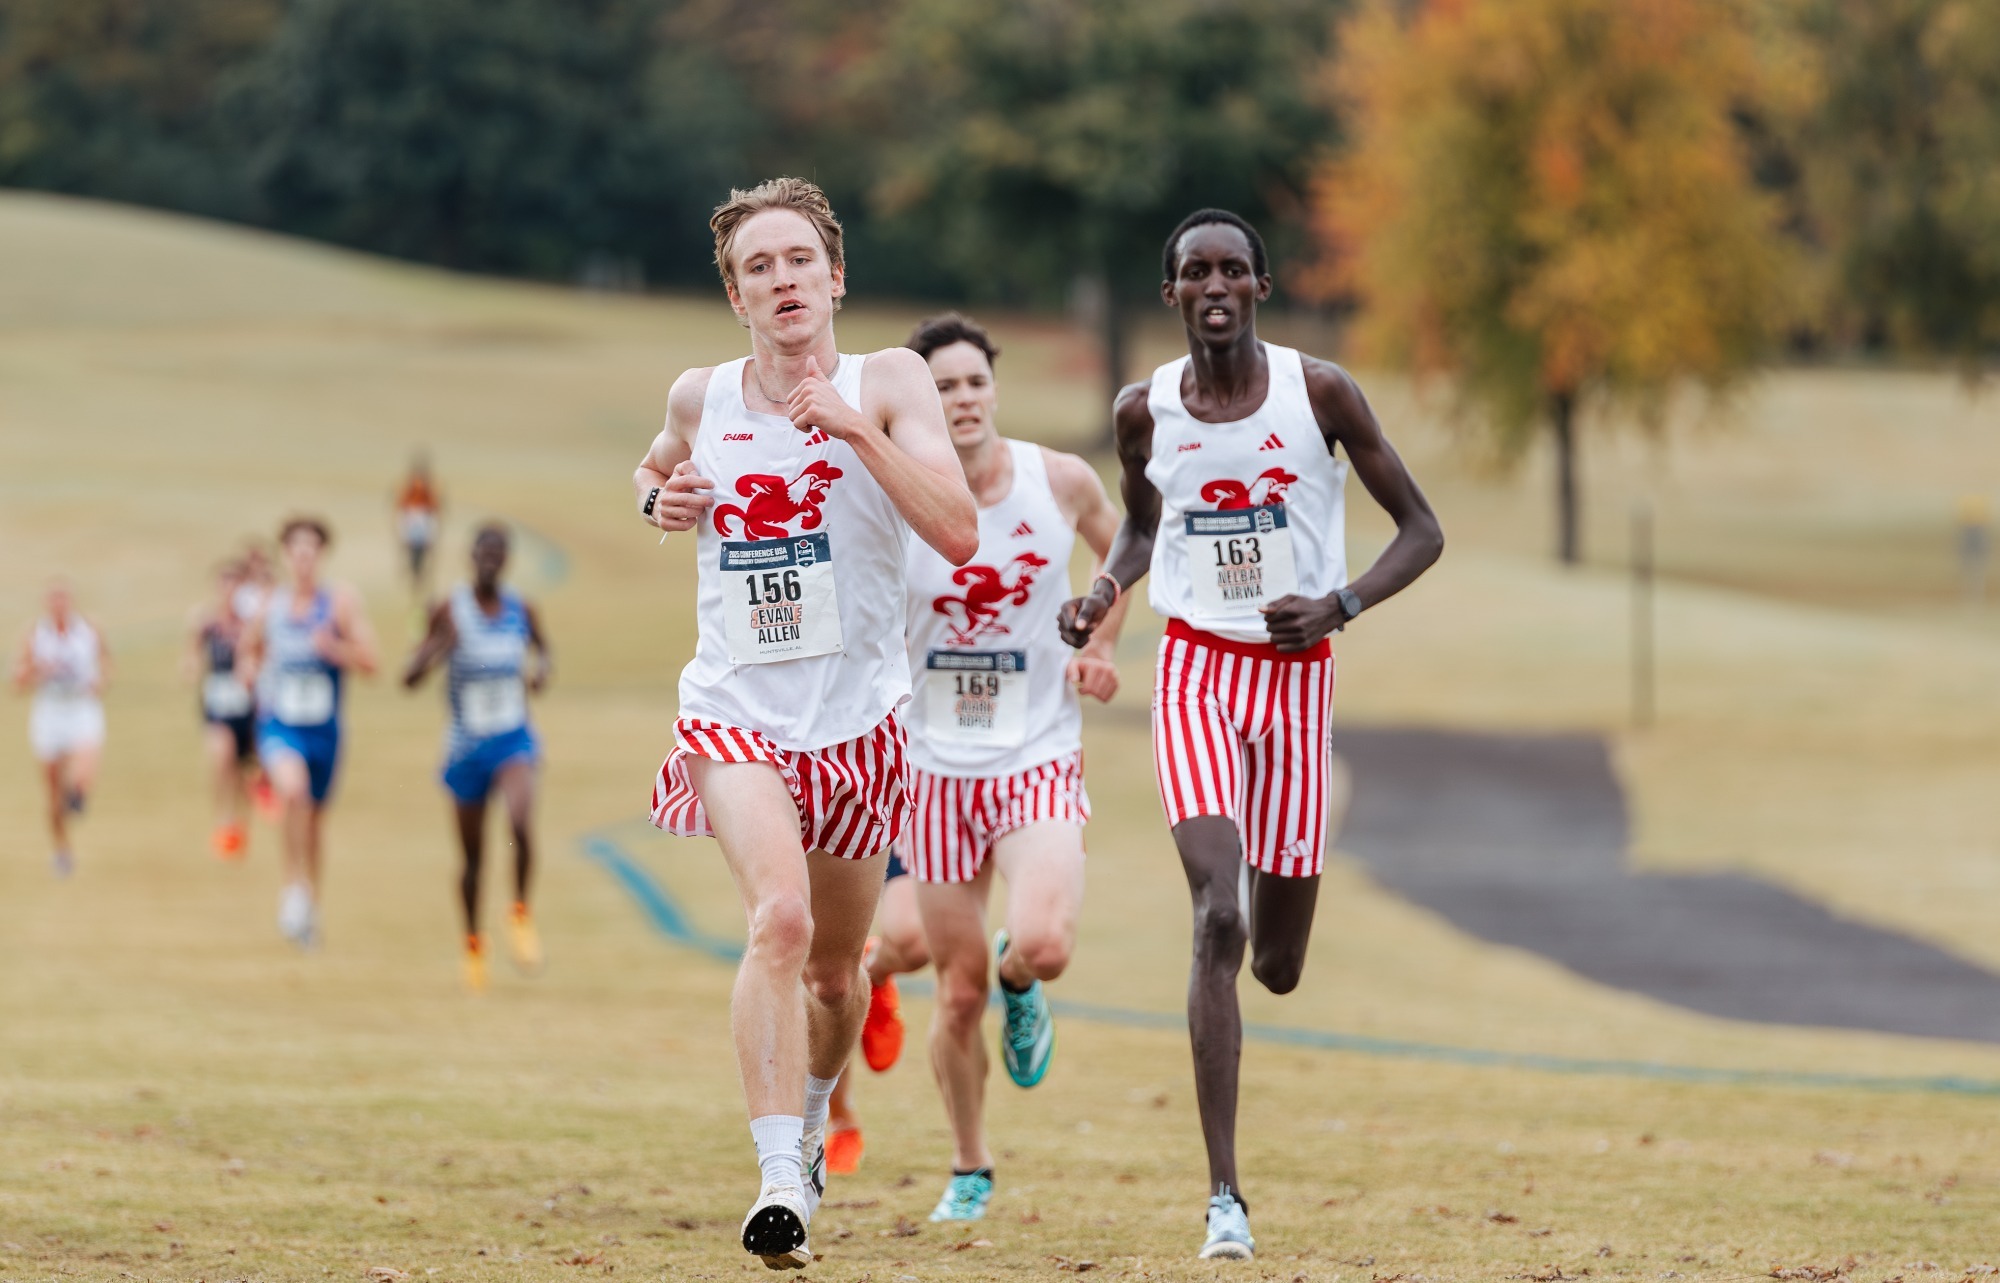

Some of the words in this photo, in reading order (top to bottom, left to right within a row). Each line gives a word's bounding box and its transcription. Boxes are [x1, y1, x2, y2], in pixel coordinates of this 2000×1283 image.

[740, 548, 774, 559] CONFERENCE
[774, 546, 788, 556] USA
[1214, 537, 1262, 566] 163
[746, 569, 802, 605] 156
[1223, 584, 1263, 600] KIRWA
[758, 606, 794, 625] EVAN
[758, 624, 800, 644] ALLEN
[956, 672, 998, 697] 169
